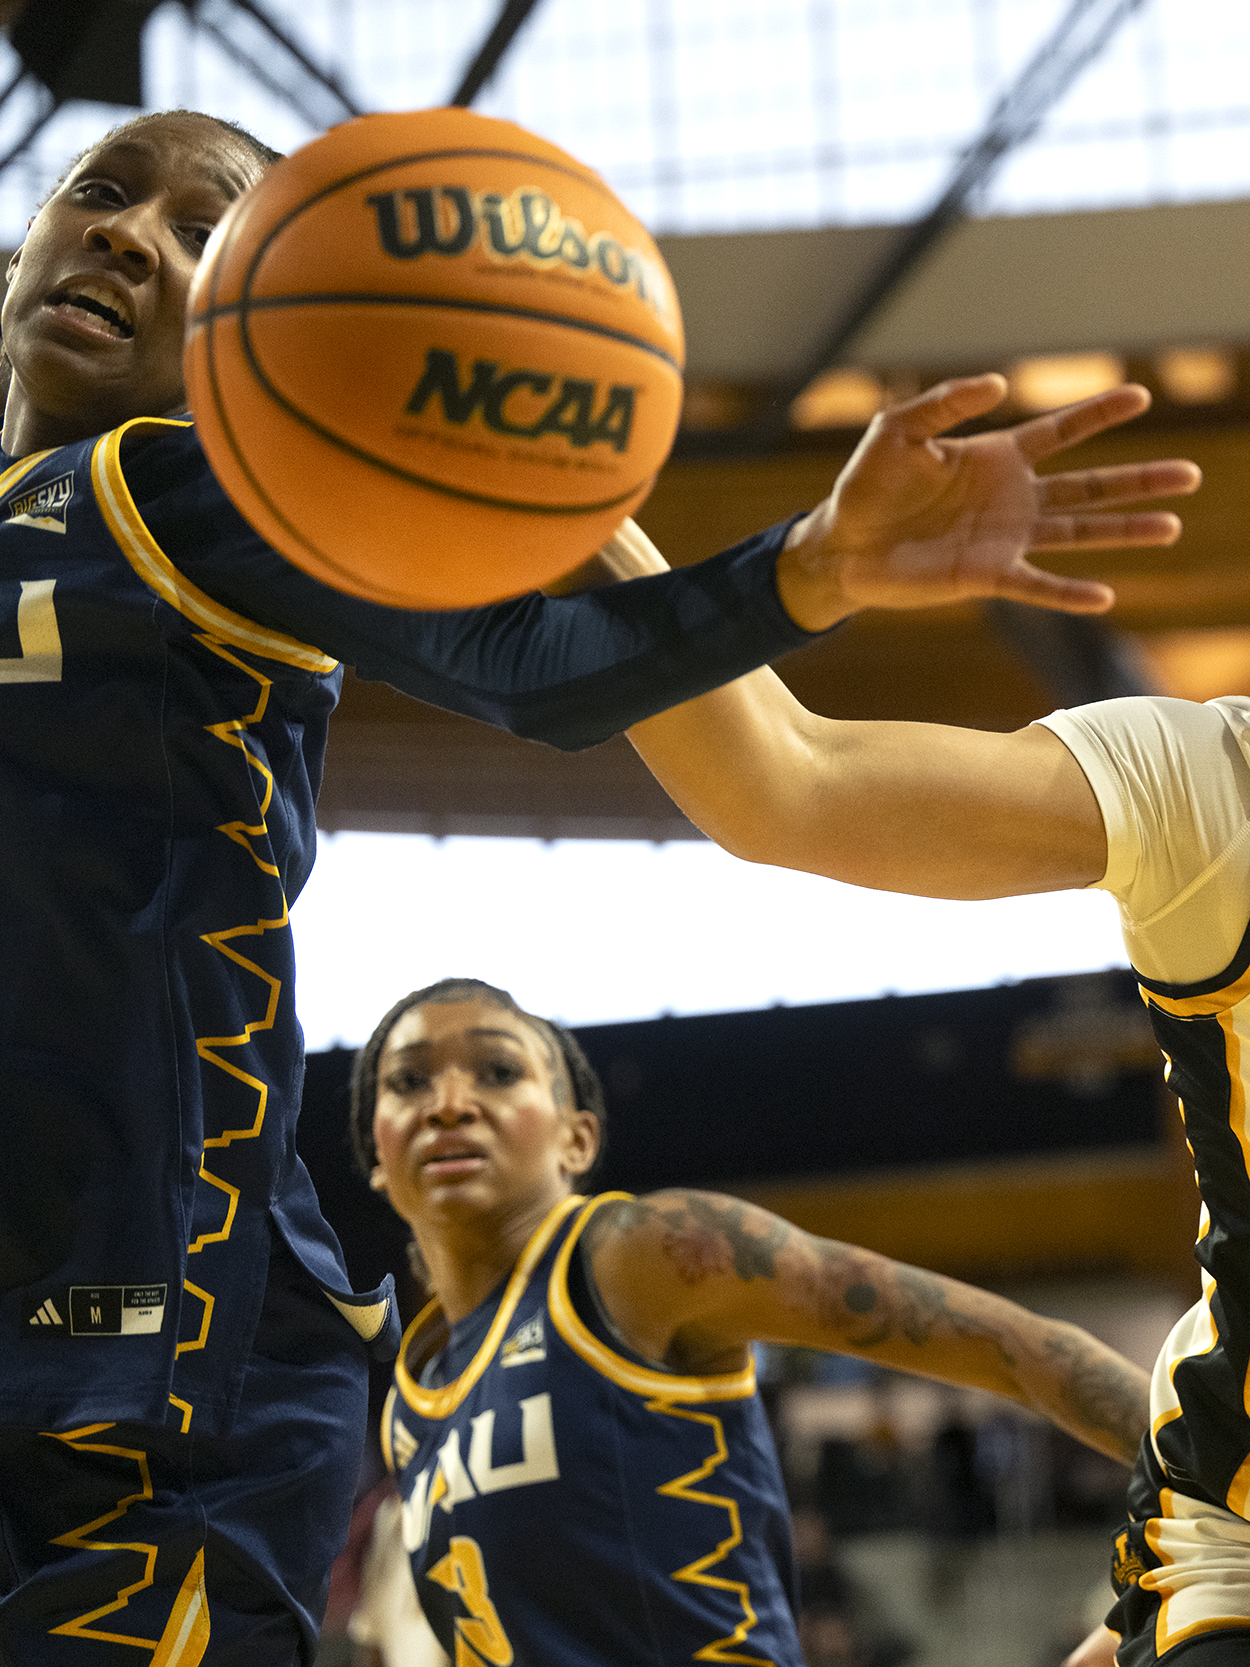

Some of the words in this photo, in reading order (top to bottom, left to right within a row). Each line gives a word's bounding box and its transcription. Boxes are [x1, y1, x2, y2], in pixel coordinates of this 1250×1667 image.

[366, 184, 664, 314] Wilson
[405, 347, 636, 454] NCAA
[90, 1306, 102, 1324] M
